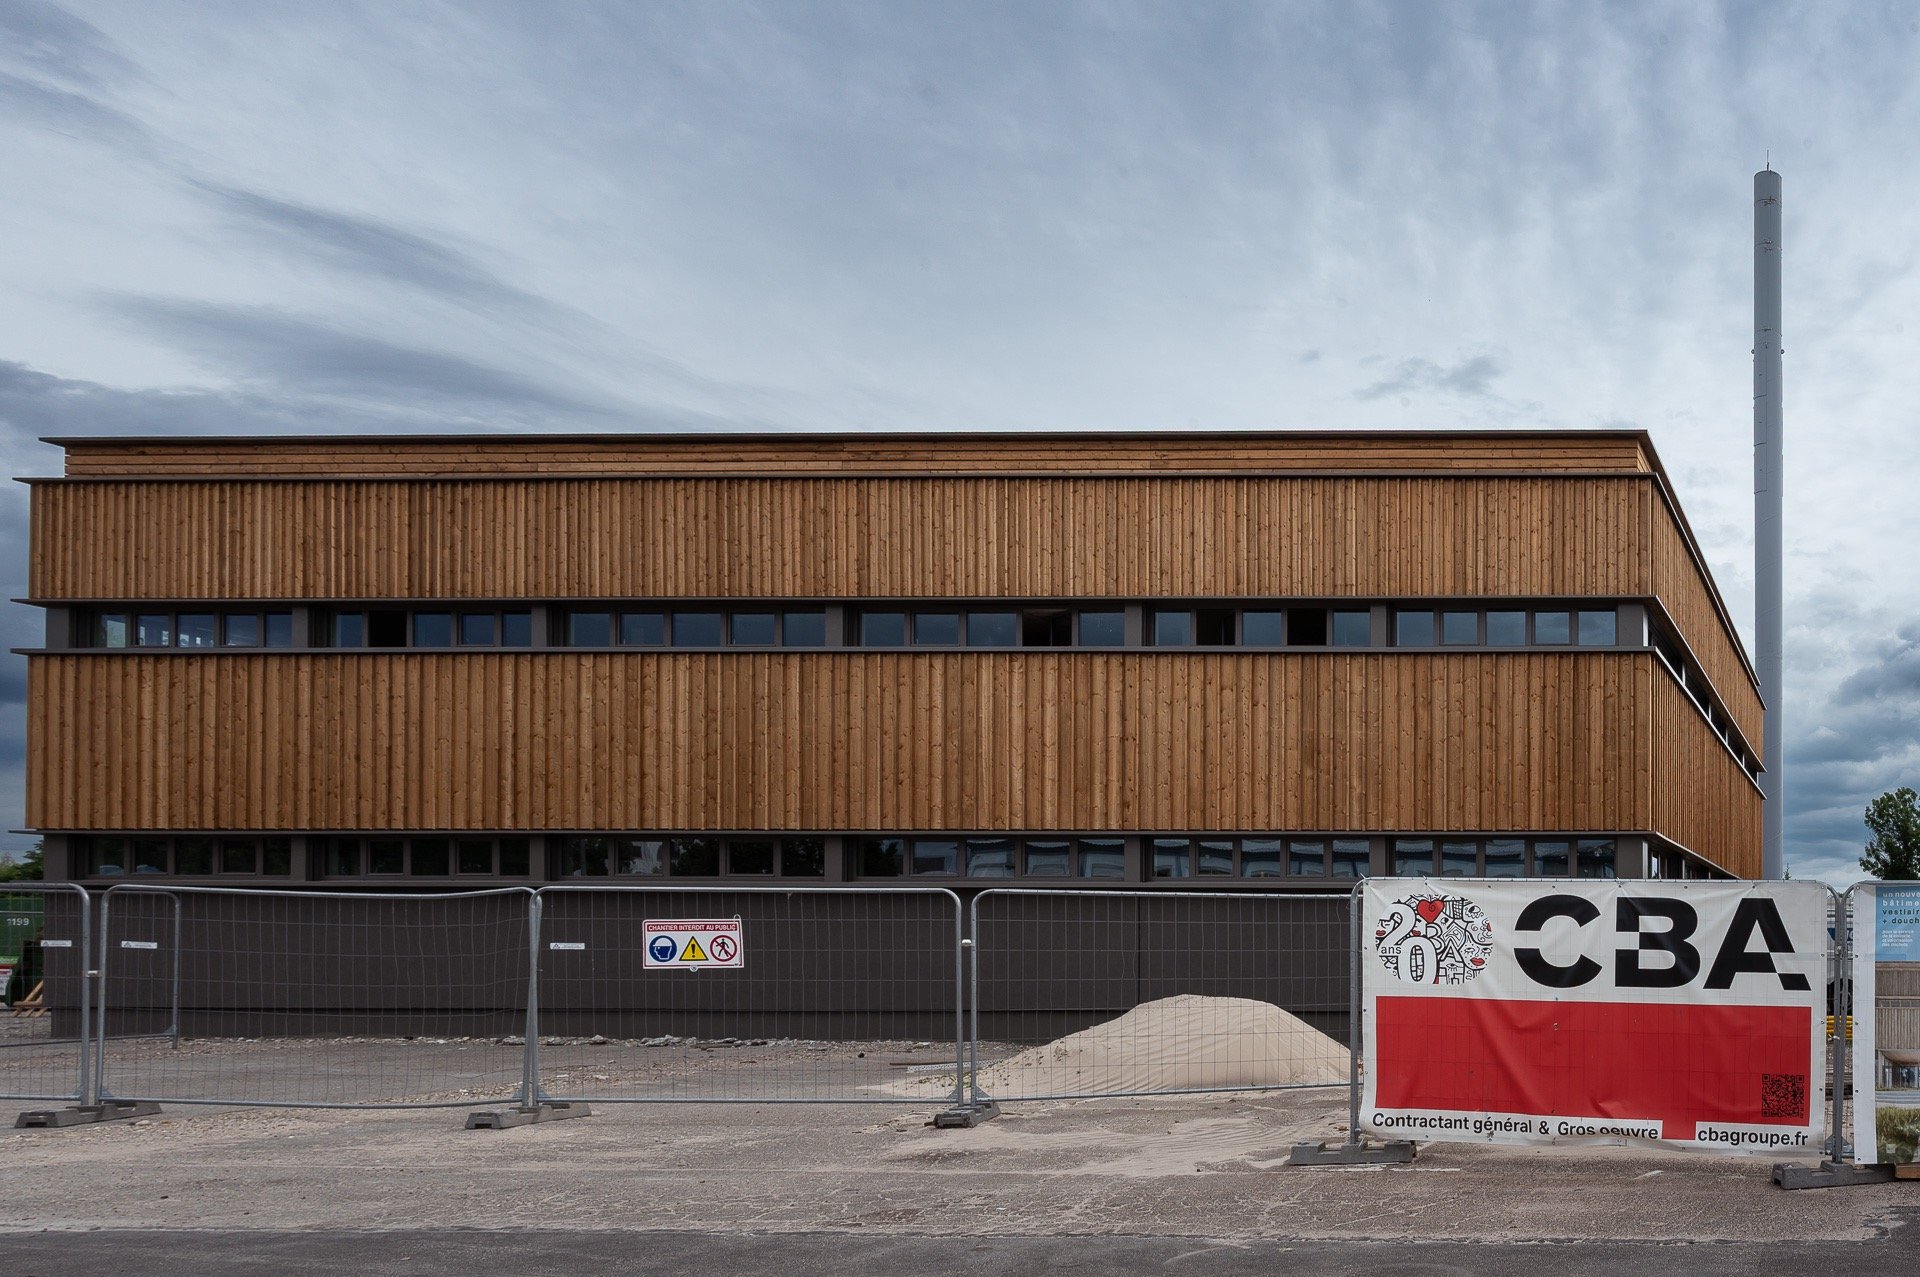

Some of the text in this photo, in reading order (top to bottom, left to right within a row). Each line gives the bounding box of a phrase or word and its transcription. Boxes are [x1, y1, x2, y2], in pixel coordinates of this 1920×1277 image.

[1381, 945, 1402, 955] ans
[1513, 893, 1812, 991] CBA
[1372, 1112, 1470, 1130] Contractant
[1473, 1116, 1532, 1134] général
[1538, 1120, 1550, 1135] &
[1557, 1121, 1595, 1136] Gros
[1697, 1127, 1809, 1148] cbagroupe.fr
